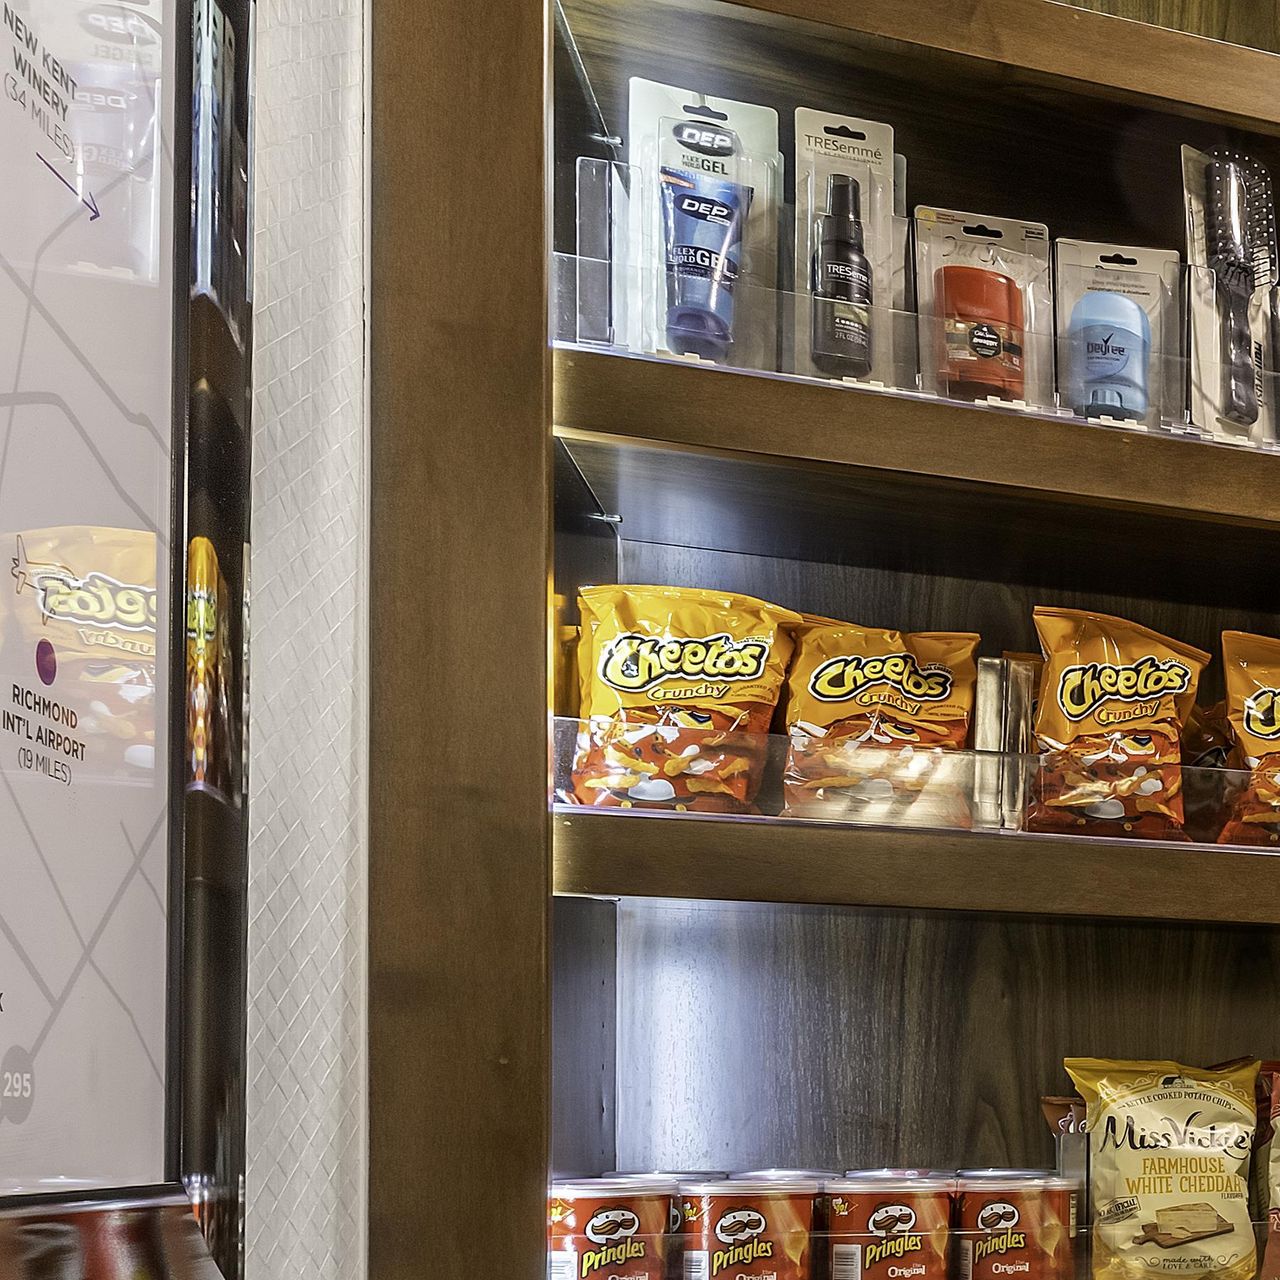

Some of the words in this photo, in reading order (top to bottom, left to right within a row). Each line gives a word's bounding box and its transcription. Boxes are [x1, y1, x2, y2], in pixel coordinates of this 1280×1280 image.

[4, 3, 38, 50] NEW
[42, 47, 78, 100] KENT
[13, 46, 69, 122] WINERY
[4, 72, 26, 110] (34
[31, 105, 76, 163] MILES)
[682, 127, 731, 149] DEP
[701, 159, 729, 175] GEL
[681, 199, 729, 216] DEP
[603, 636, 768, 690] Cheetos
[811, 655, 952, 699] Cheetos
[650, 682, 730, 700] Crunchy
[856, 692, 921, 714] Crunchy
[1060, 658, 1190, 718] Cheetos
[12, 684, 78, 729] RICHMOND
[1094, 701, 1158, 725] Crunchy
[2, 710, 33, 740] INT'L
[35, 725, 86, 761] AIRPORT
[18, 746, 33, 769] (19
[36, 756, 72, 786] MILES)
[3, 1071, 31, 1098] 295
[1142, 1156, 1225, 1176] FARMHOUSE
[1125, 1175, 1173, 1195] WHITE
[1180, 1174, 1242, 1194] CHEDDAR
[580, 1238, 645, 1279] Pringles
[712, 1239, 773, 1277] Pringles
[865, 1232, 923, 1269] Pringles
[974, 1229, 1025, 1263] Pringles
[886, 1264, 927, 1279] Original
[991, 1261, 1030, 1276] Original
